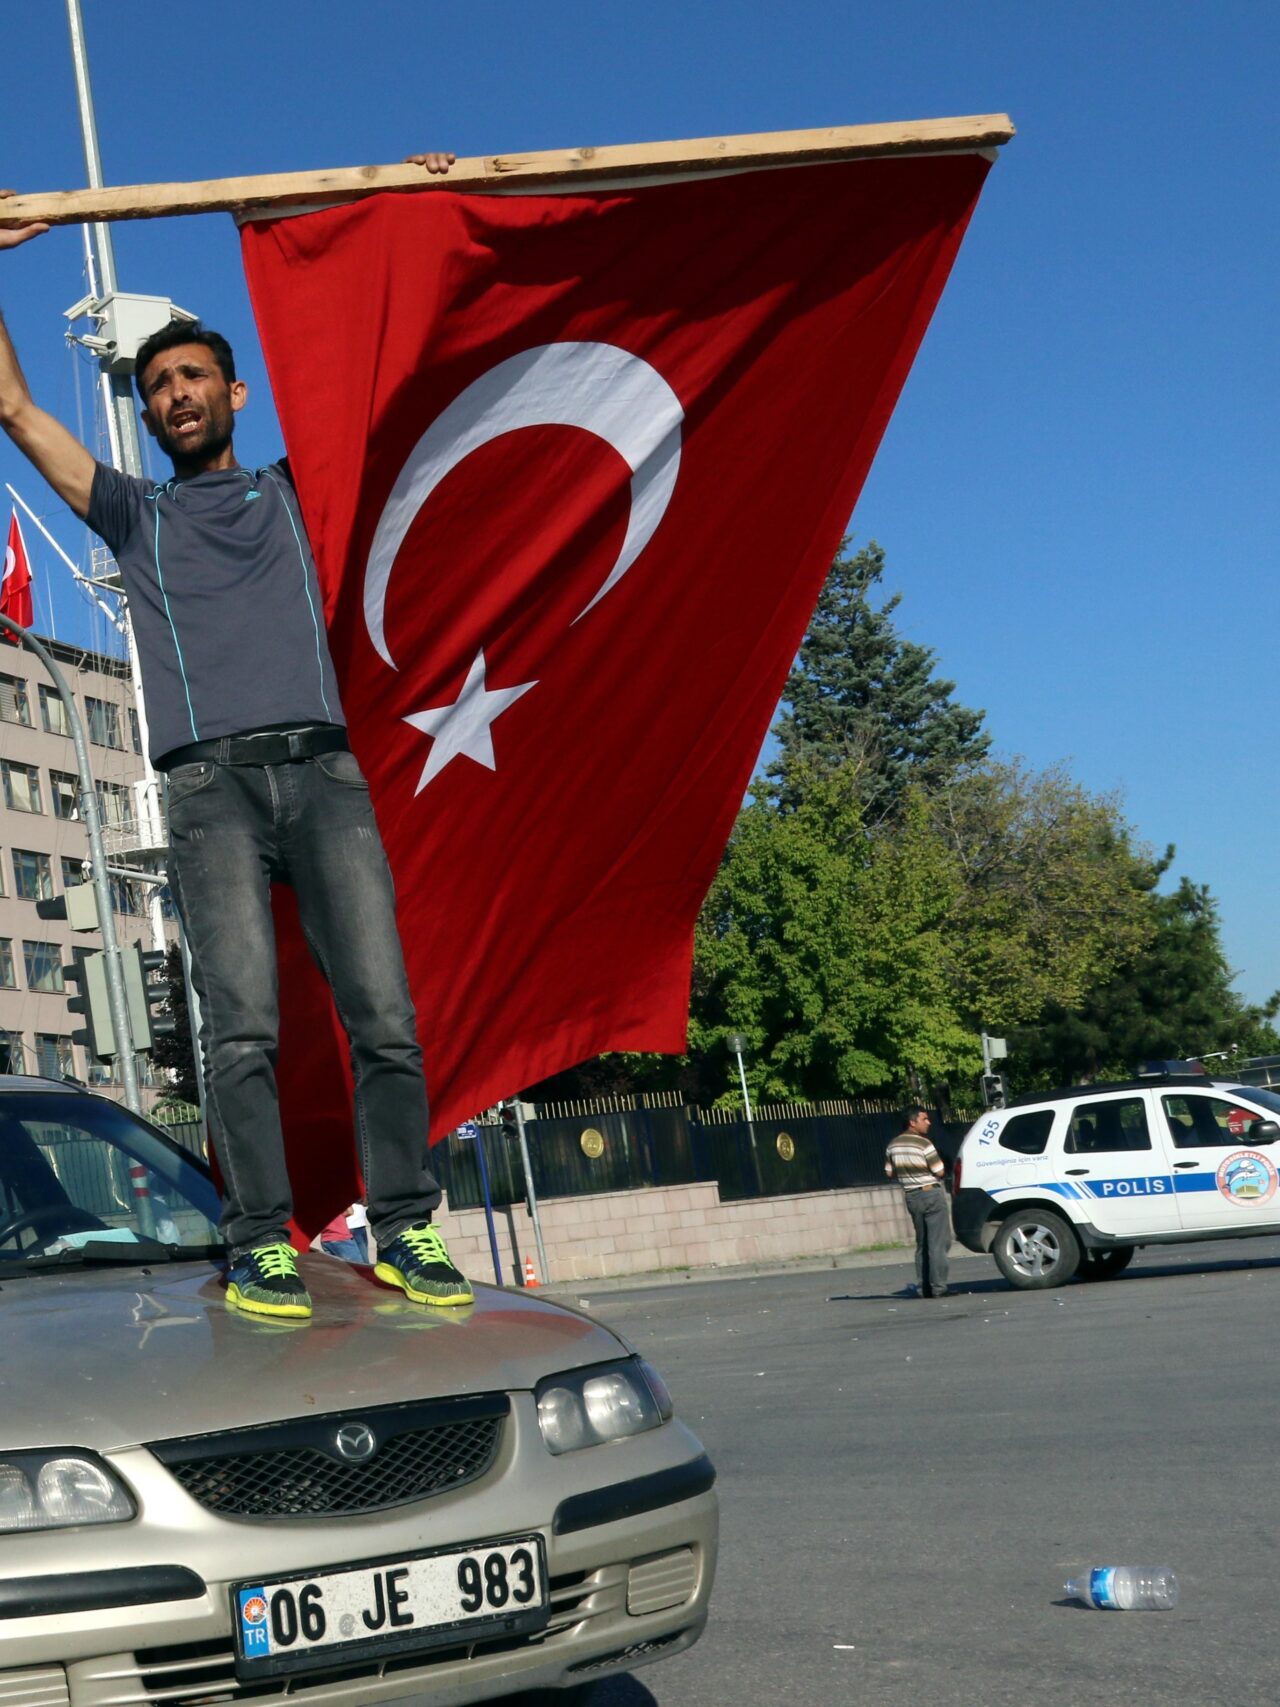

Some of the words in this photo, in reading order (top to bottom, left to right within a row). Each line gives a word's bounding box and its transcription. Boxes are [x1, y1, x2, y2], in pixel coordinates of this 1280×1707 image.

[978, 1120, 1000, 1146] 155
[1102, 1178, 1165, 1196] POLİS
[270, 1584, 327, 1646] 06
[362, 1568, 414, 1630] JE
[457, 1549, 536, 1613] 983
[245, 1629, 265, 1646] TR
